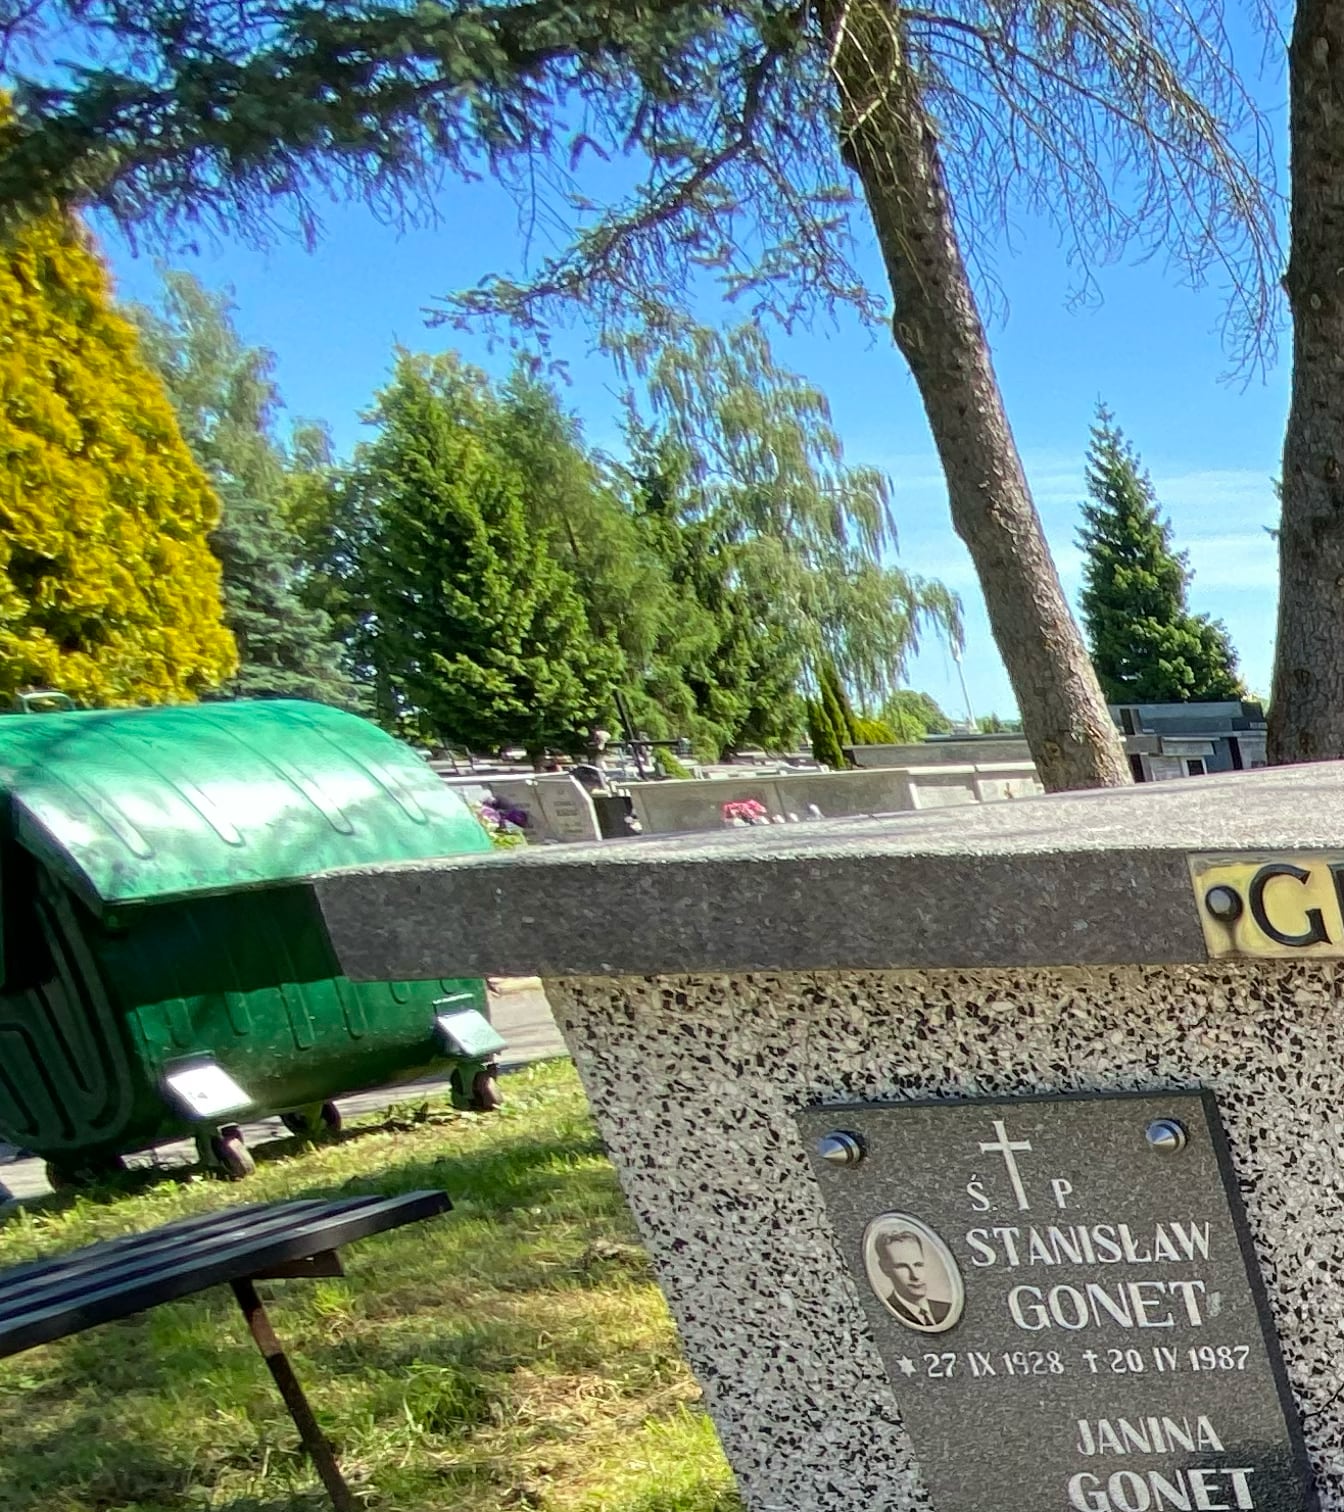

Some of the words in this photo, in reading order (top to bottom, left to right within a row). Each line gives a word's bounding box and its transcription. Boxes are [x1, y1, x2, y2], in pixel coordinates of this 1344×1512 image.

[965, 1220, 1212, 1268] STANISŁAW
[1007, 1279, 1206, 1331] GONET
[923, 1352, 957, 1377] 27
[967, 1351, 997, 1376] IX
[1003, 1350, 1065, 1375] 1928
[1107, 1348, 1145, 1374] 20
[1152, 1346, 1178, 1371] IV
[1188, 1344, 1251, 1371] 1987
[1076, 1414, 1225, 1457] JANINA
